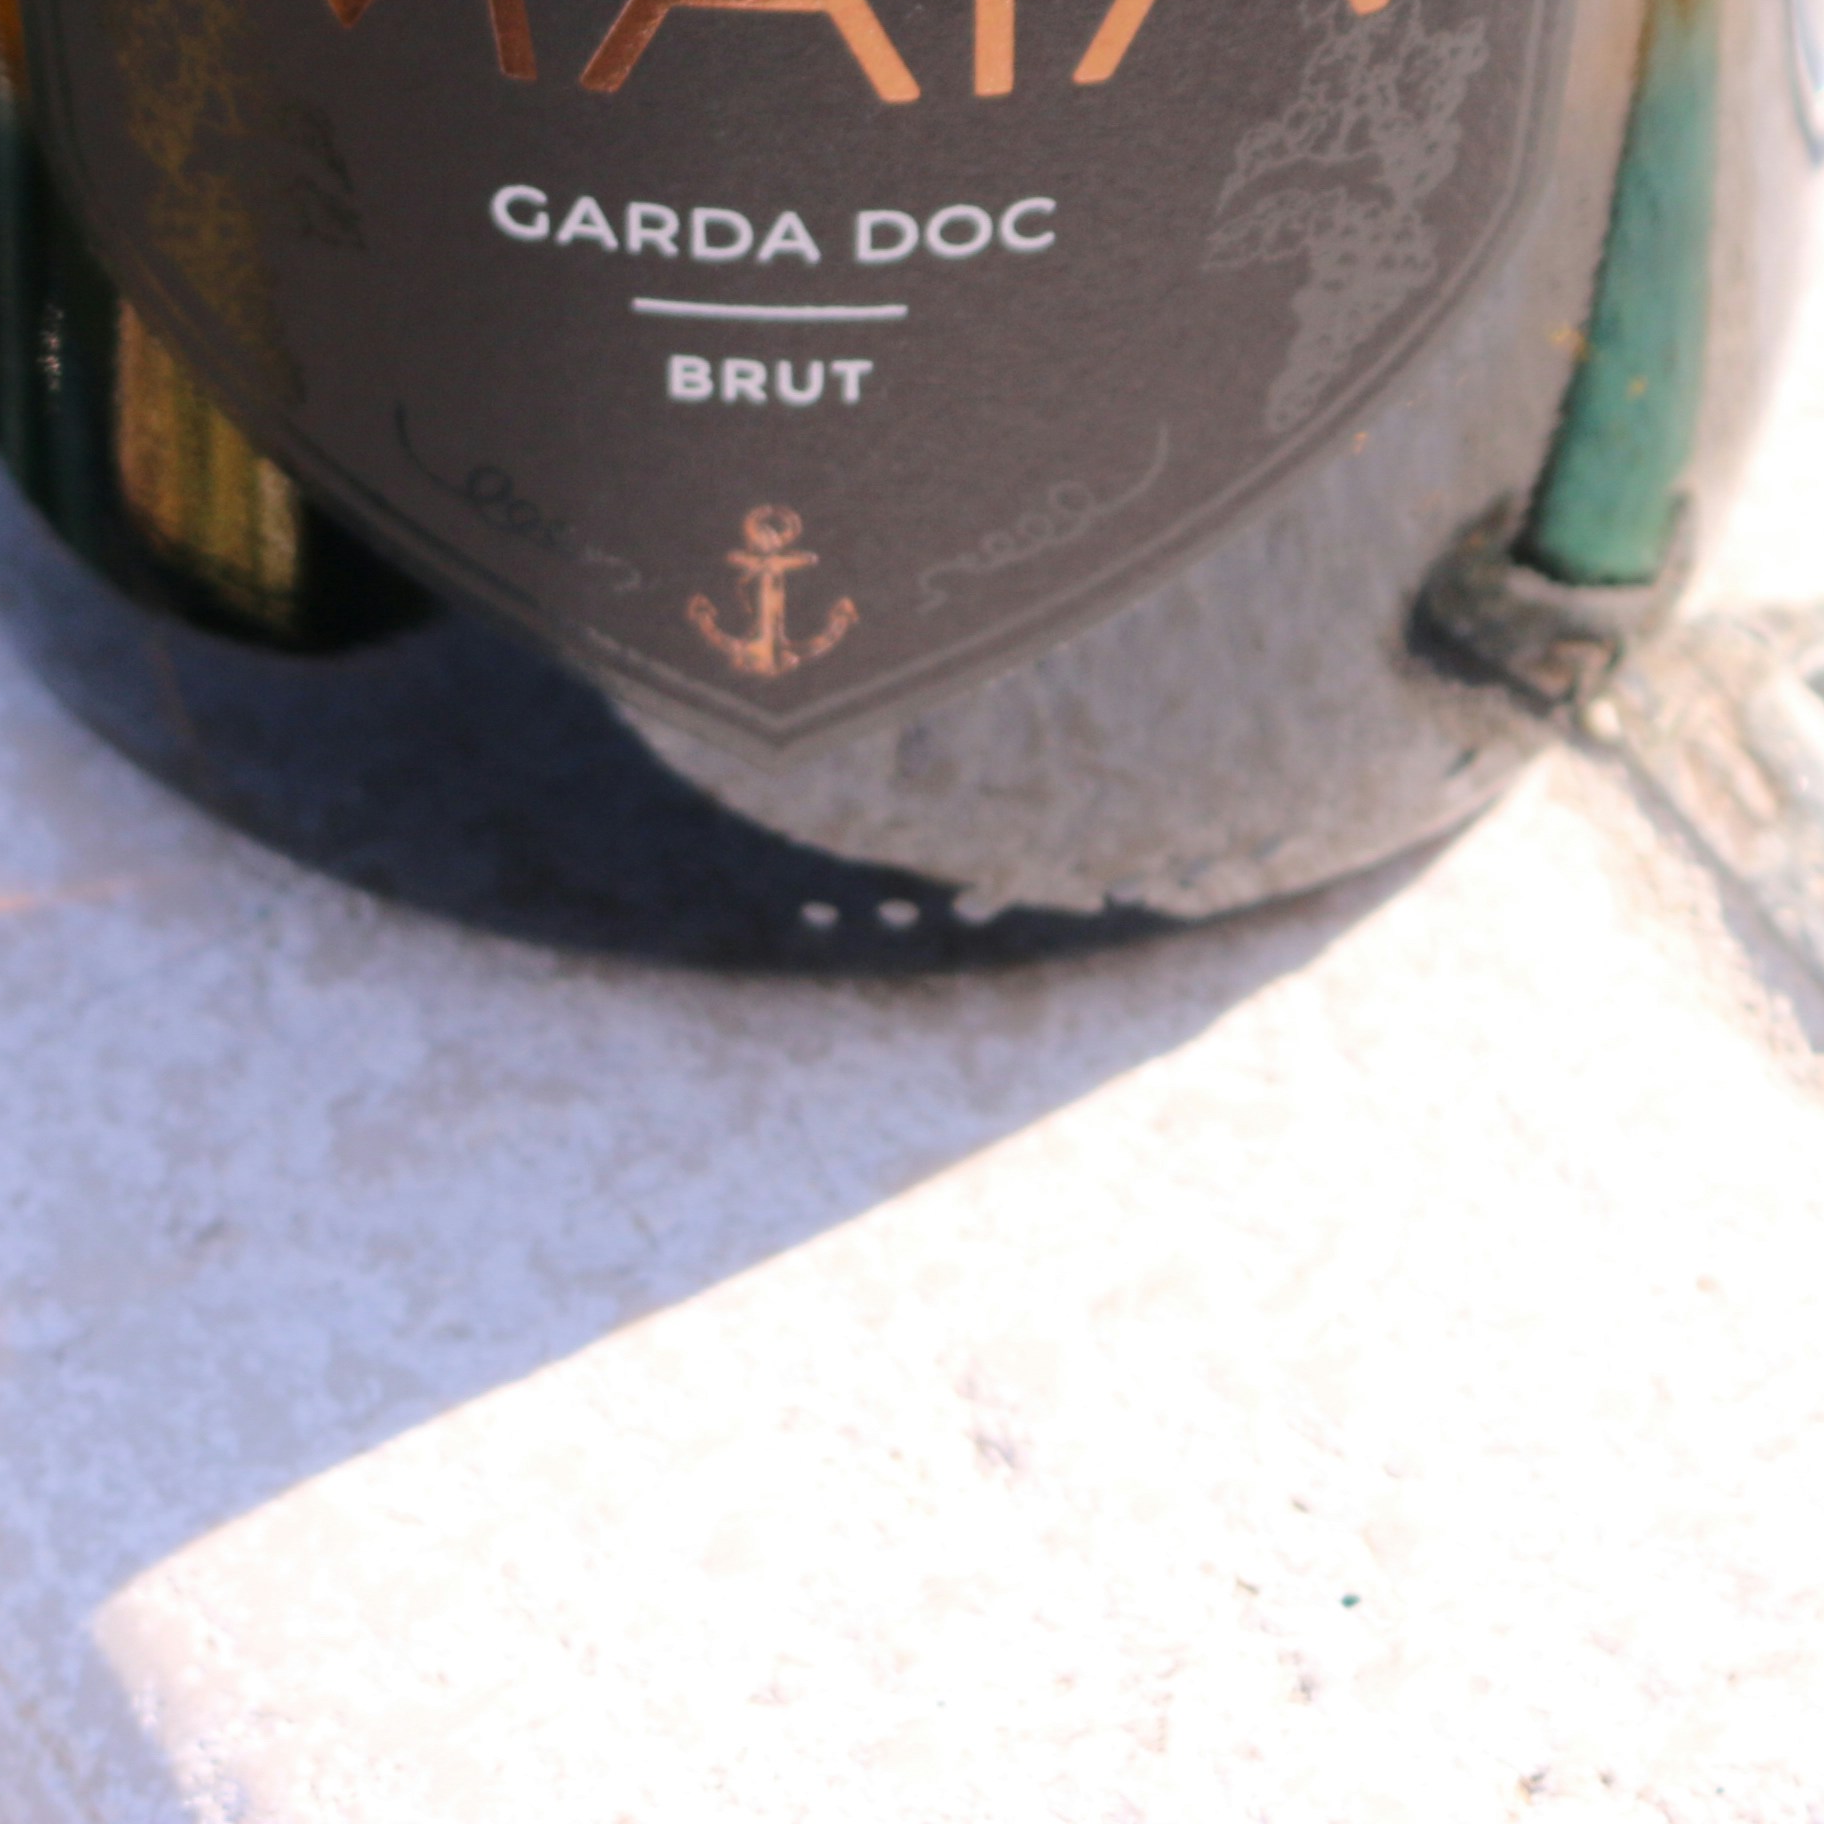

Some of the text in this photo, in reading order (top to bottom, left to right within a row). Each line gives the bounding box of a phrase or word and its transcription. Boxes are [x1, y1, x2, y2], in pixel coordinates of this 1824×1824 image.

[489, 183, 1059, 264] GARDA DOC
[666, 353, 874, 405] BRUT
